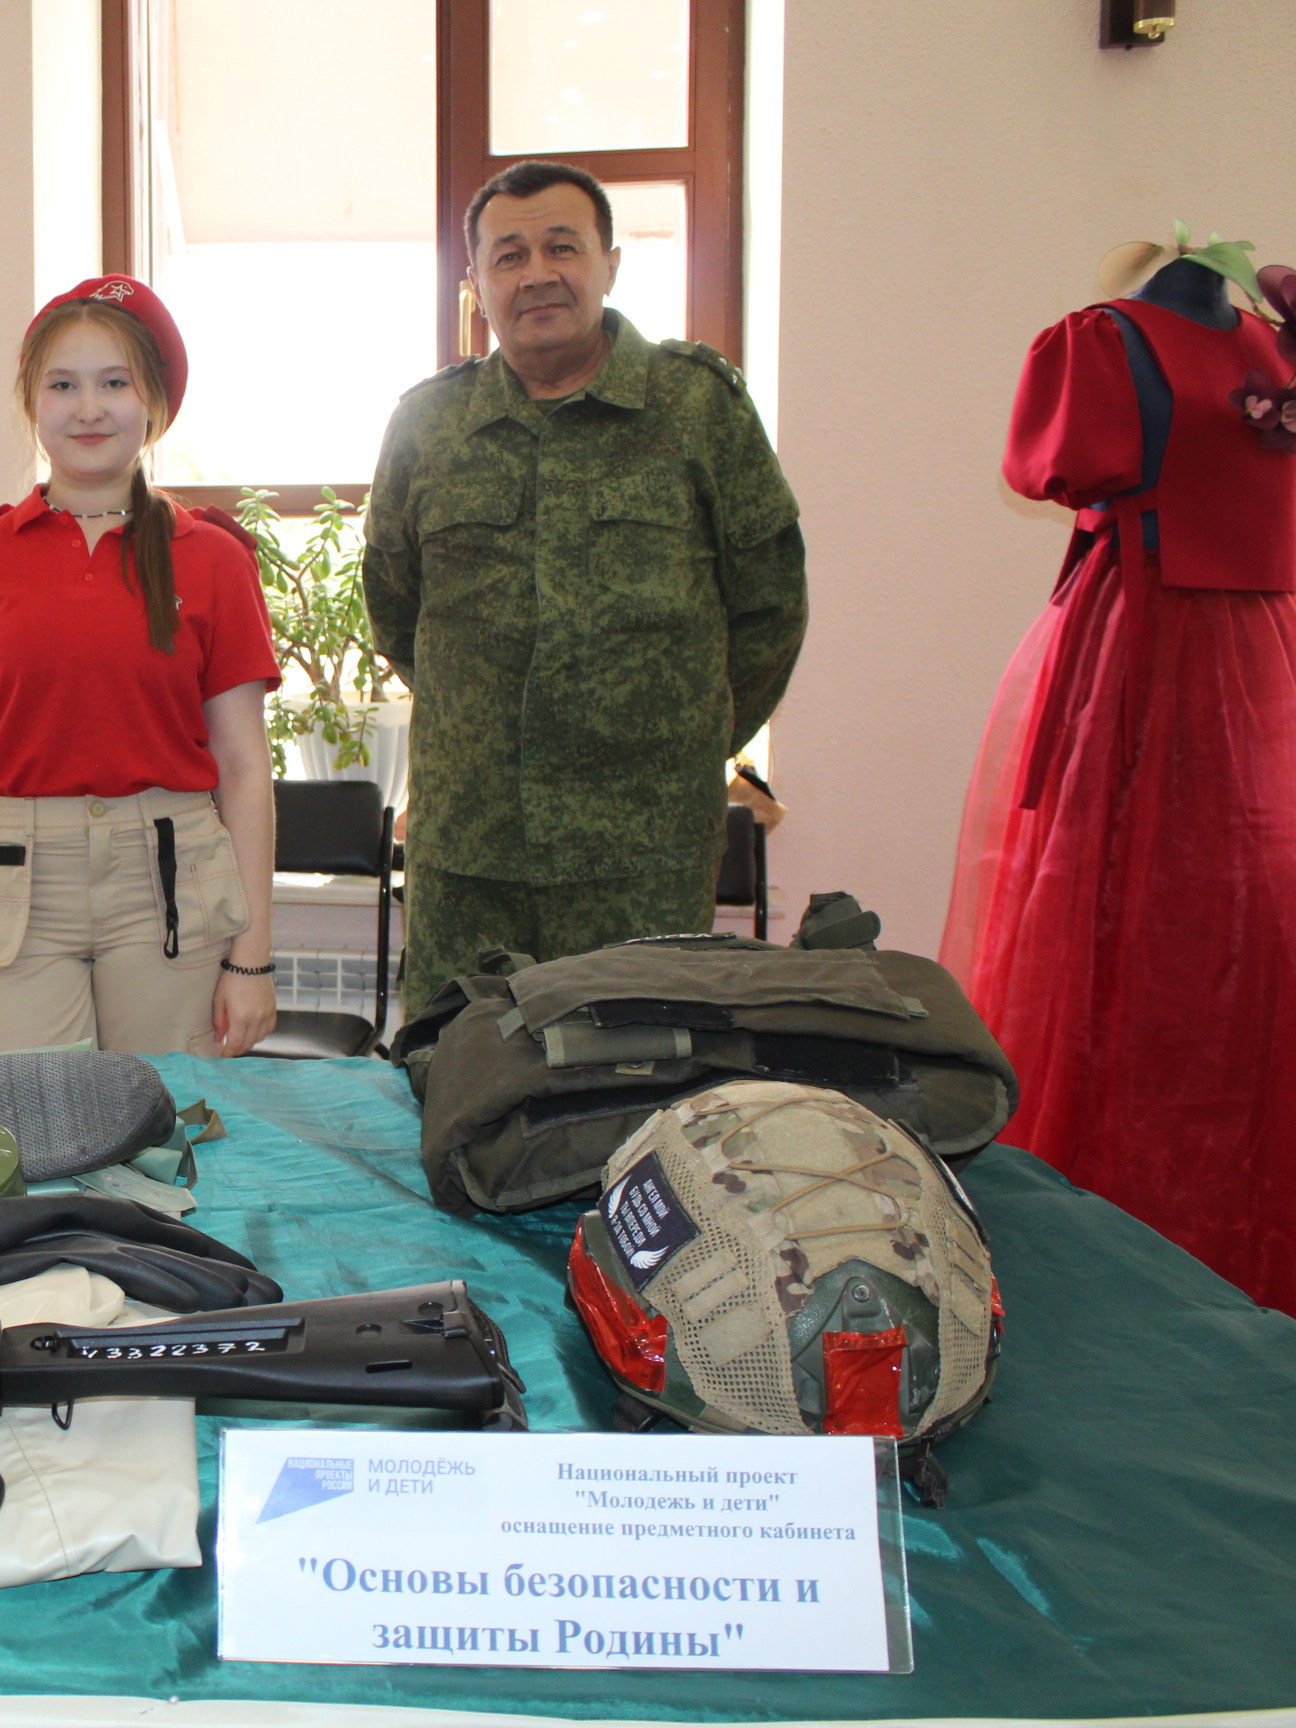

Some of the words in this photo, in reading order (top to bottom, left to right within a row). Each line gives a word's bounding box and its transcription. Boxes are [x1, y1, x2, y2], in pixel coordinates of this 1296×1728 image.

[629, 1186, 643, 1208] БУДЬ
[643, 1179, 660, 1204] АНГЕЛ
[653, 1199, 670, 1219] МОЙ
[620, 1201, 631, 1217] ТЫ
[638, 1203, 649, 1217] СО
[625, 1211, 646, 1247] ВПЕРЕДИ
[642, 1212, 661, 1237] МНОЙ
[287, 1459, 353, 1470] НАЦИОНАЛЬНЫЕ
[315, 1470, 353, 1480] ПРОЕКТЫ
[368, 1458, 476, 1477] МОЛОДЁЖЬ
[557, 1462, 719, 1484] Национальный
[725, 1469, 798, 1488] проект
[321, 1480, 353, 1490] РОССИИ
[368, 1478, 380, 1493] И
[385, 1478, 434, 1496] ДЕТИ
[575, 1490, 695, 1510] "Молодежь
[703, 1495, 715, 1510] и
[721, 1494, 780, 1513] дети"
[501, 1519, 615, 1537] оснащение
[620, 1522, 753, 1541] предметного
[759, 1522, 856, 1541] кабинета
[298, 1557, 489, 1597] "Основы
[504, 1563, 782, 1603] безопасности
[795, 1578, 820, 1604] и
[372, 1622, 540, 1655] защиты
[554, 1619, 744, 1661] Родины"
